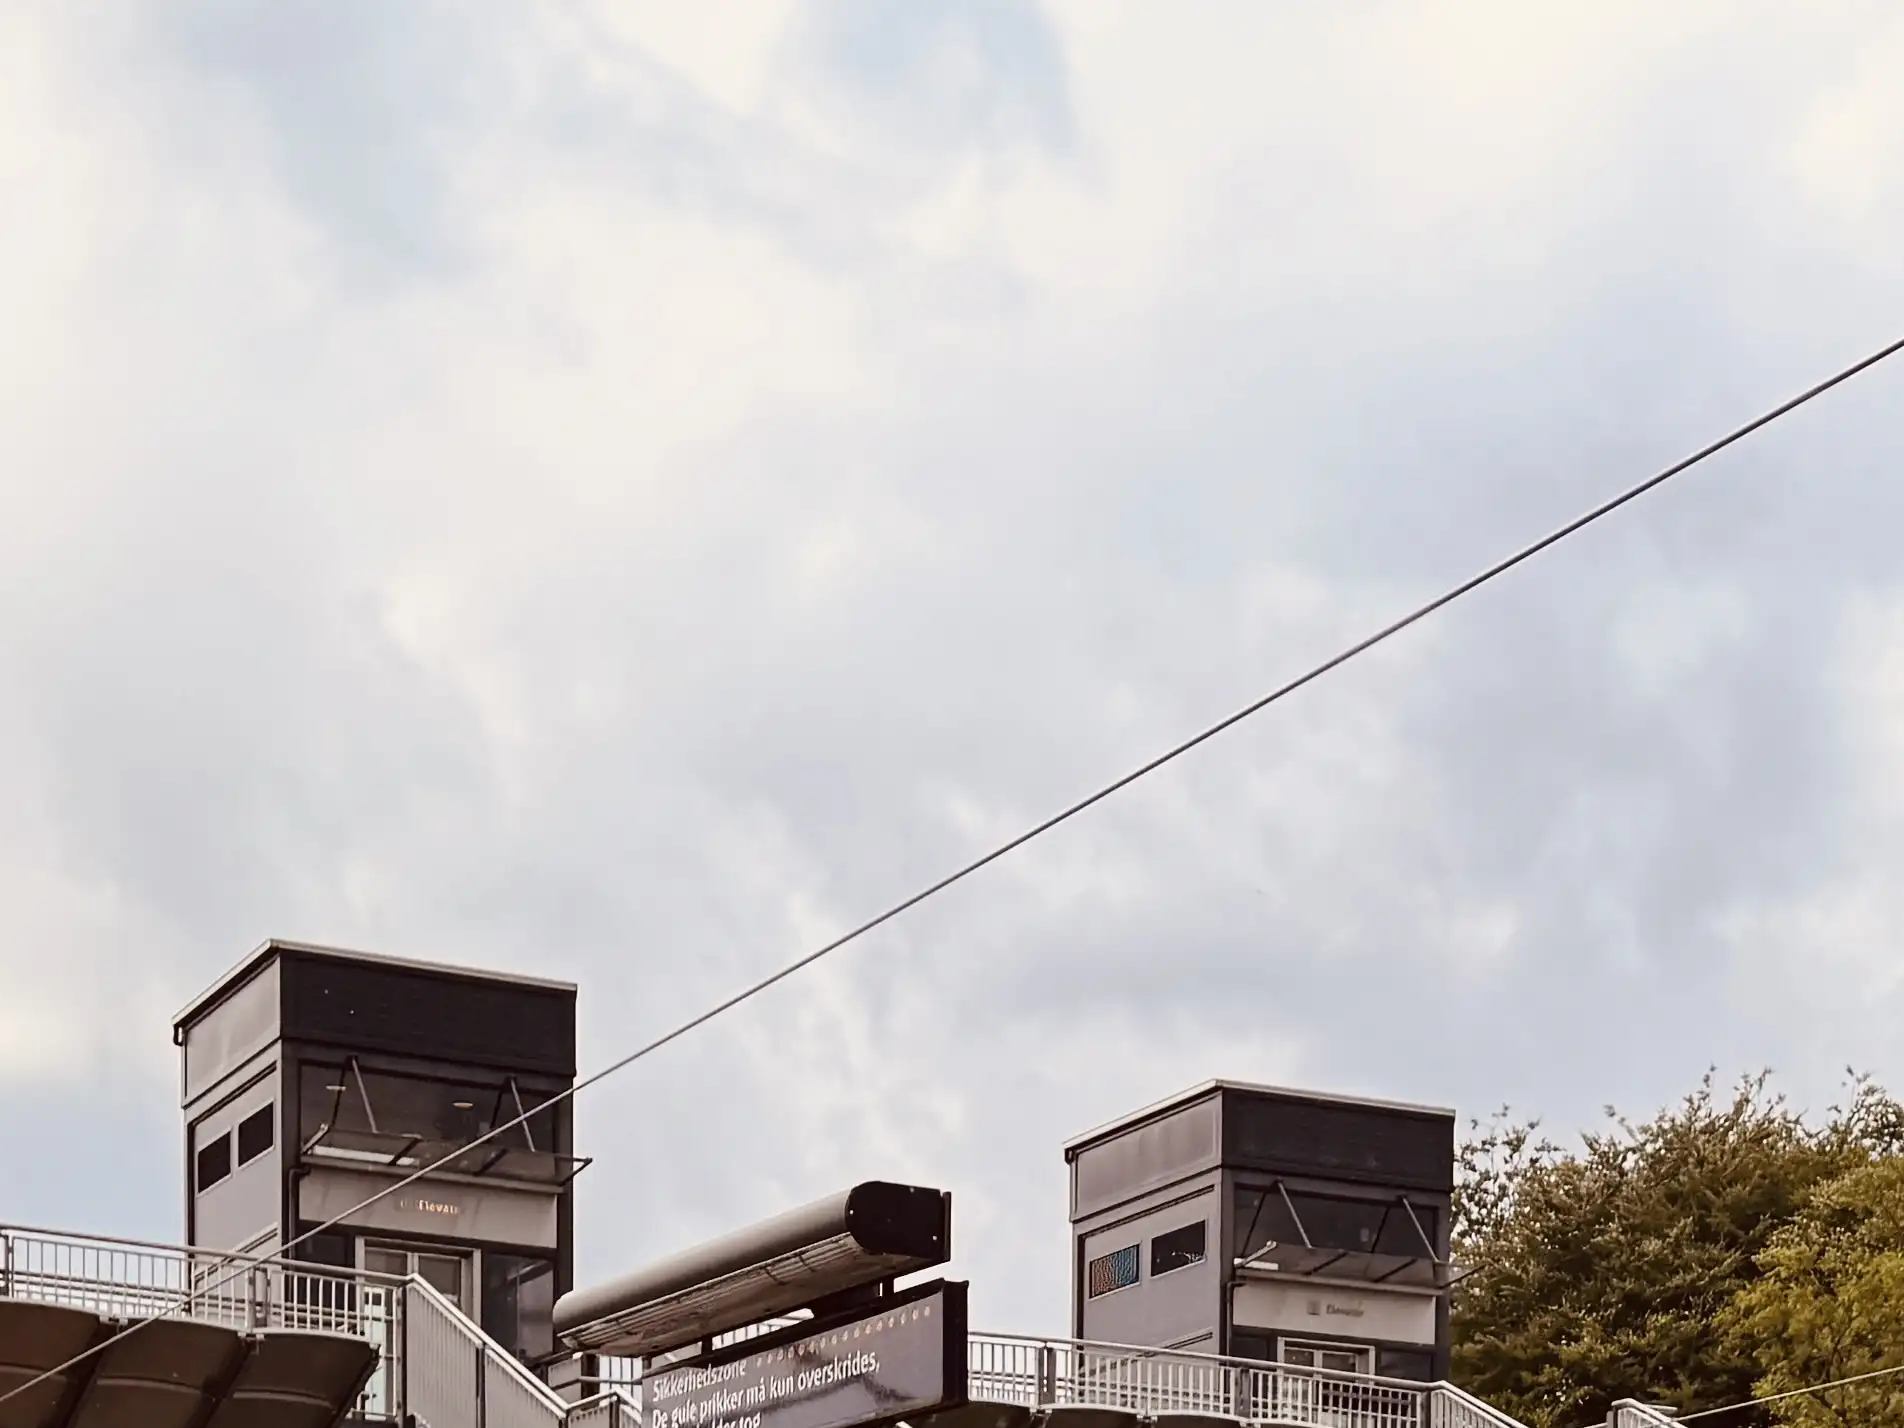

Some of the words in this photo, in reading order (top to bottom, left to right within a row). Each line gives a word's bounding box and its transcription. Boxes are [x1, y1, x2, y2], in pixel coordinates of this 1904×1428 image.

[653, 1360, 746, 1401] Sikkerhedszone
[700, 1388, 744, 1422] prikker
[746, 1377, 766, 1406] må
[770, 1374, 794, 1399] kun
[798, 1350, 880, 1391] overskrides,
